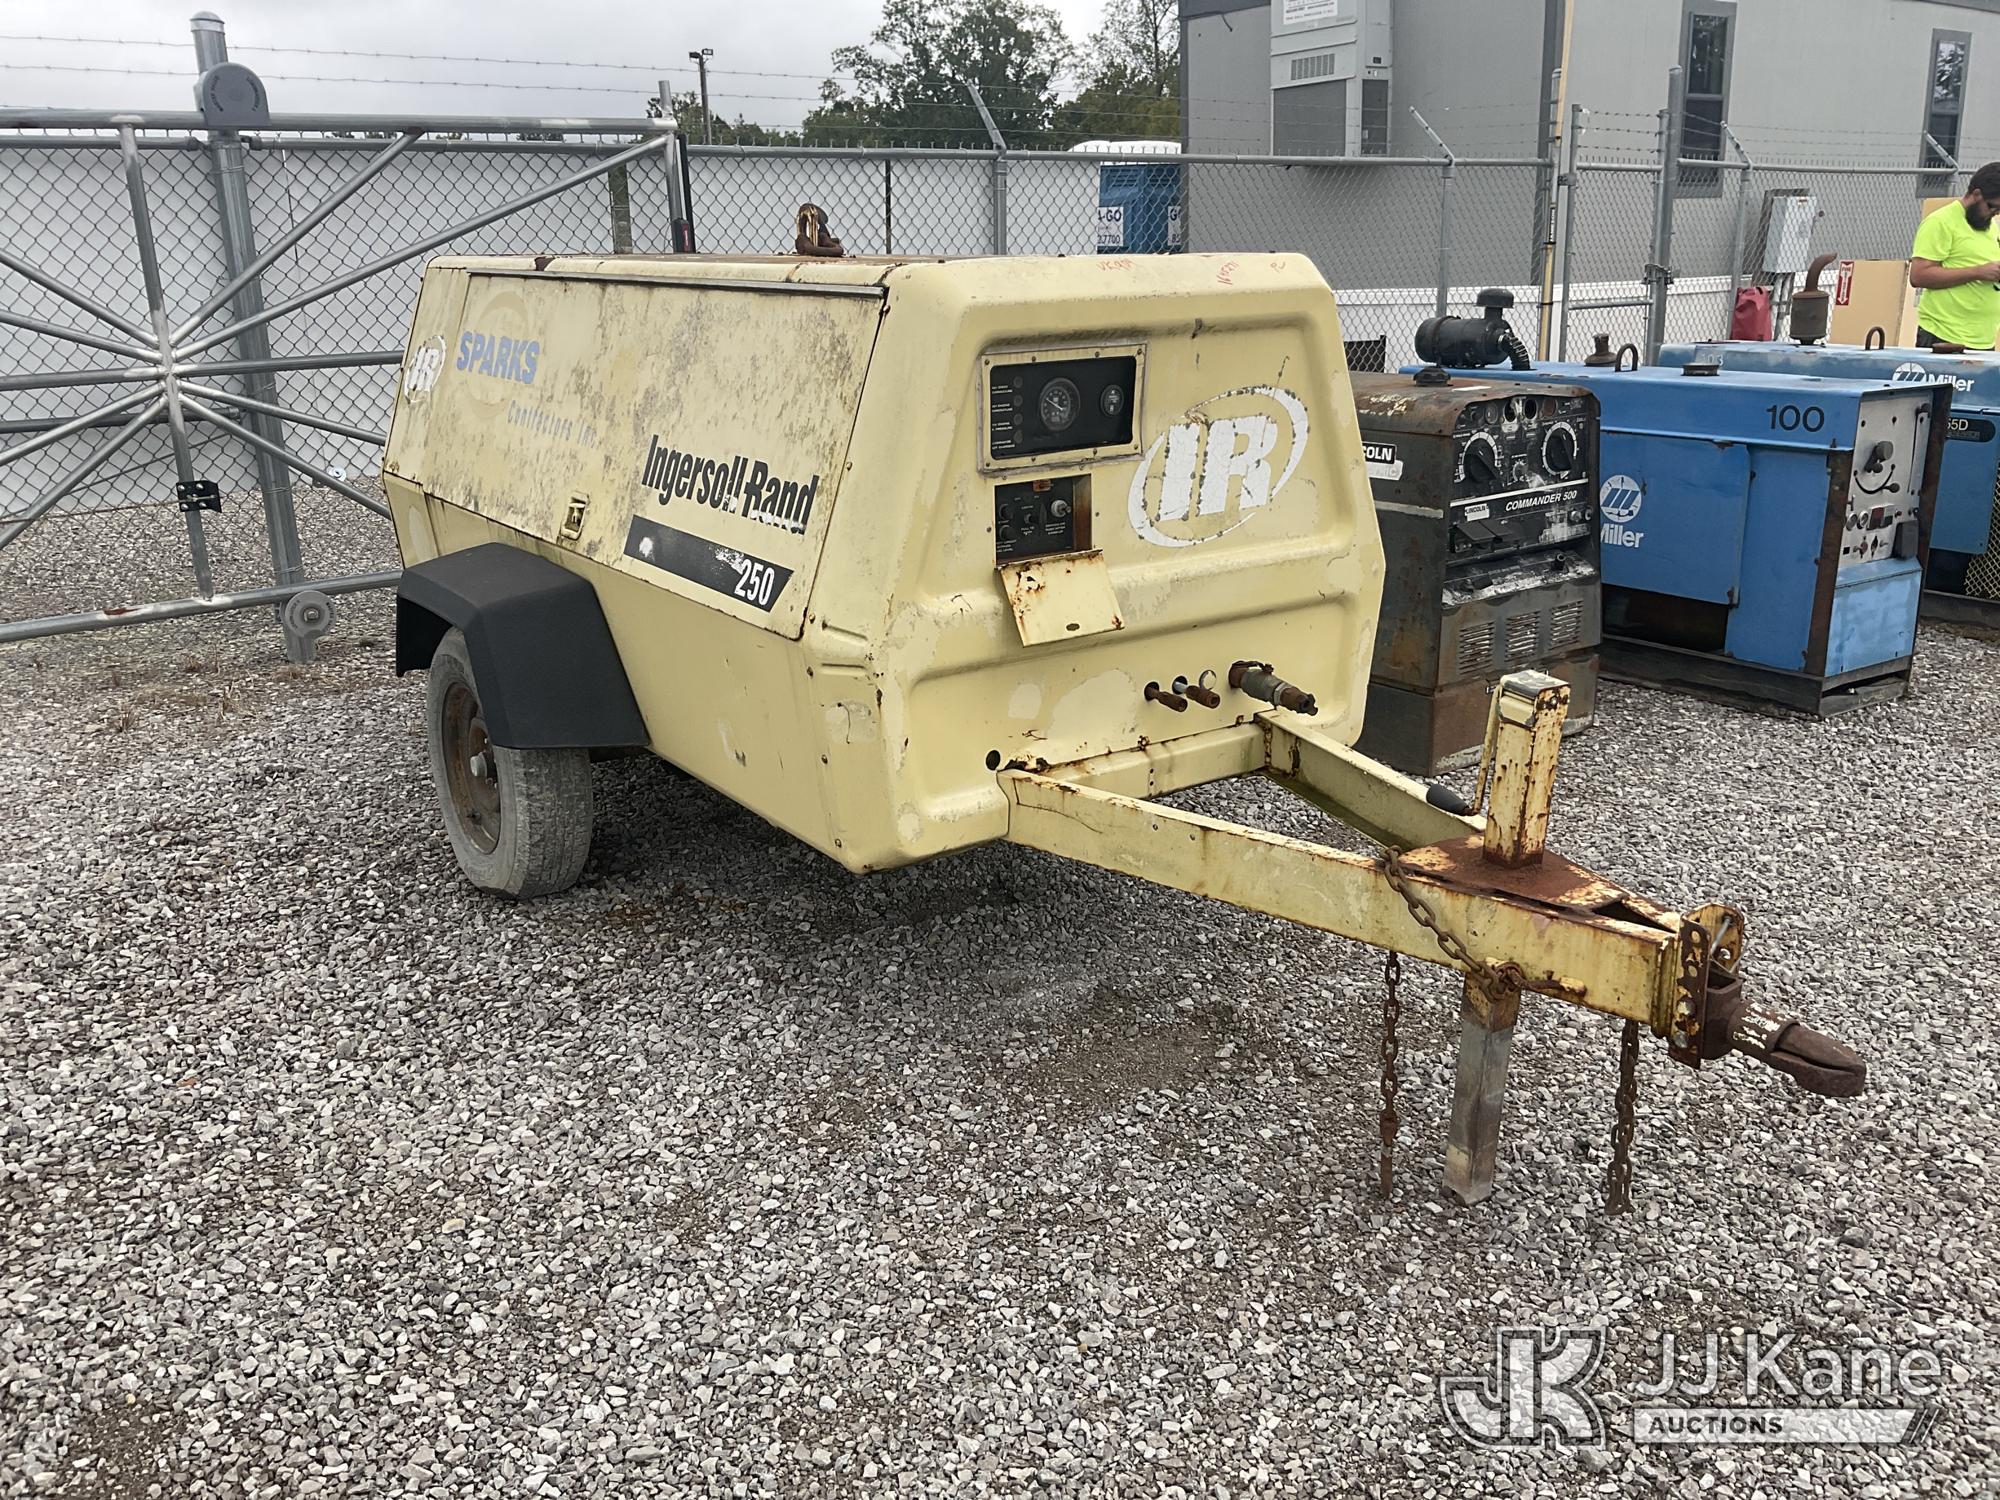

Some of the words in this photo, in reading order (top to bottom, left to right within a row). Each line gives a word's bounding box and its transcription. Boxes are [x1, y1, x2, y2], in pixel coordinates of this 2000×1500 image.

[456, 330, 541, 385] SPARKS
[1928, 373, 1975, 392] Miller
[1766, 405, 1825, 432] 100
[1158, 415, 1278, 521] IR
[1505, 493, 1562, 512] COMMANDER
[1562, 490, 1578, 501] 500
[734, 558, 775, 606] 250
